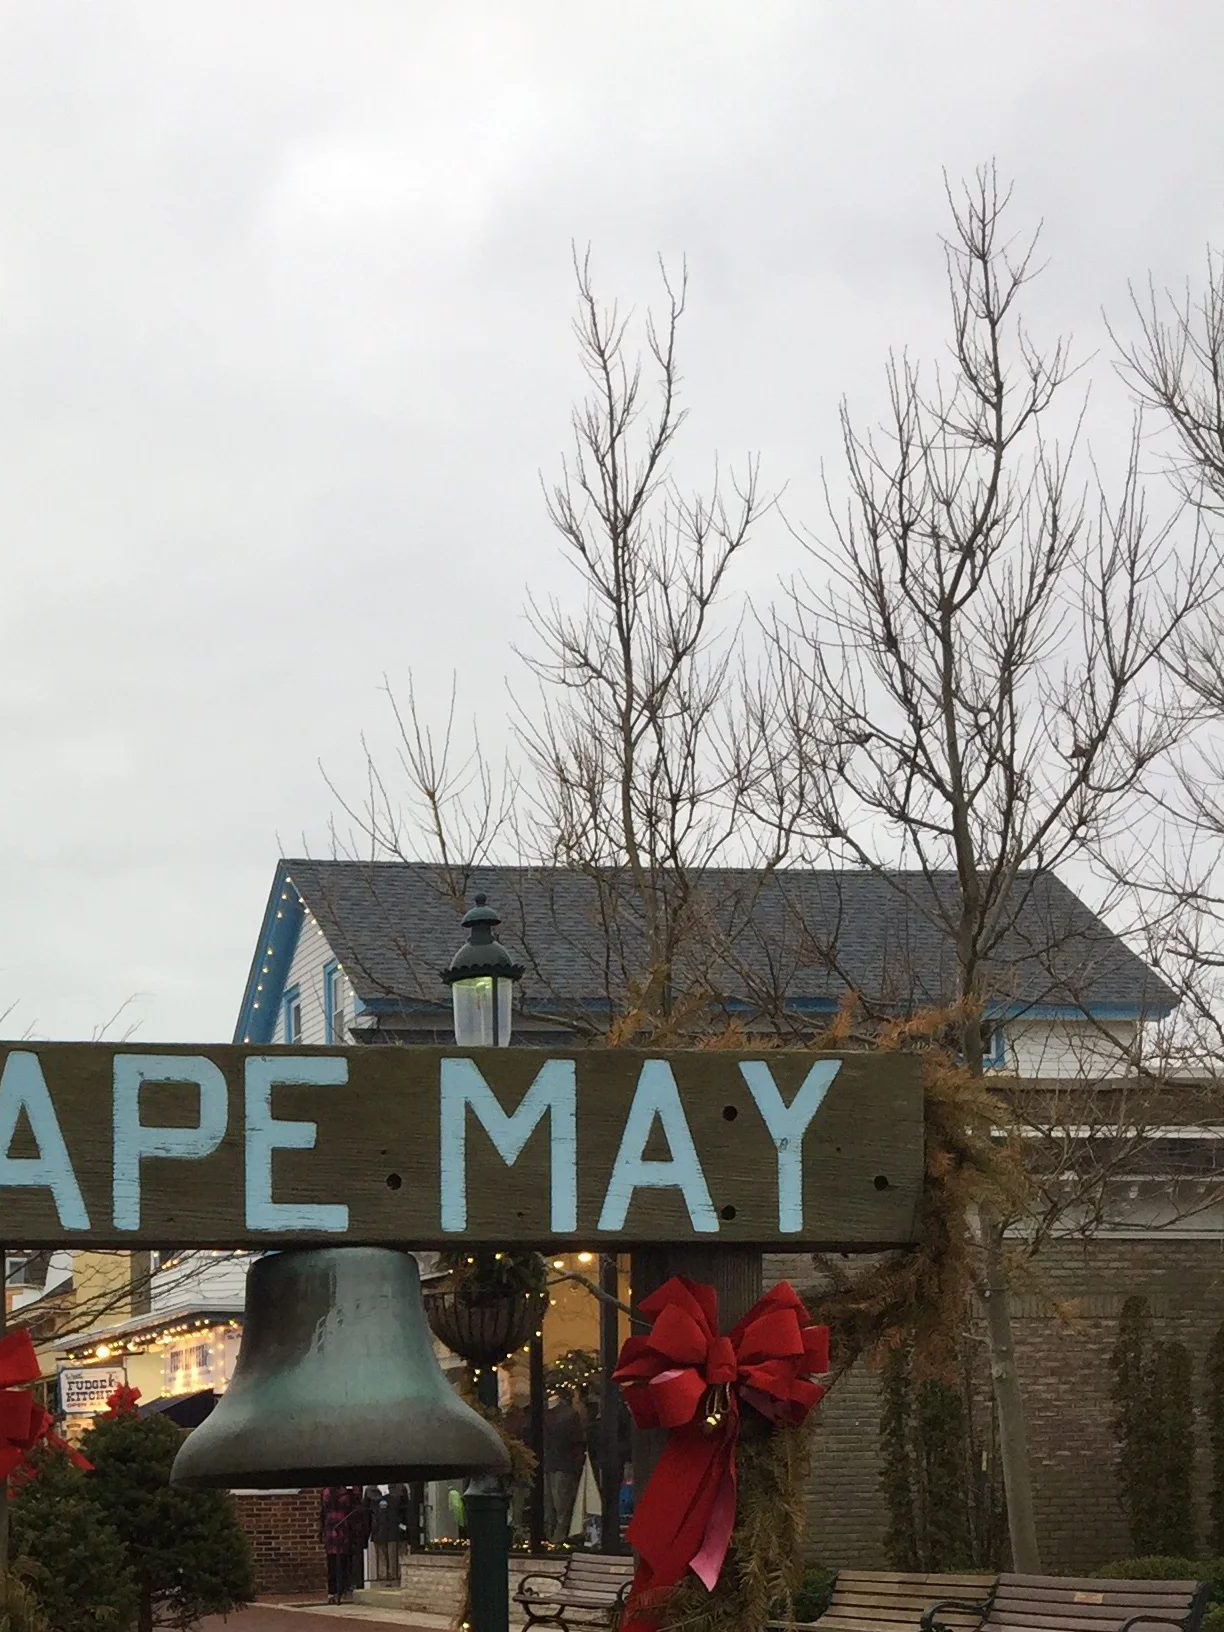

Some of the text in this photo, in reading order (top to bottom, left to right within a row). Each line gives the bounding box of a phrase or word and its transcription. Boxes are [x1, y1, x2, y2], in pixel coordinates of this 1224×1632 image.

[440, 1057, 843, 1233] MAY
[67, 1379, 107, 1391] FUDGE
[65, 1389, 117, 1402] KITCHE
